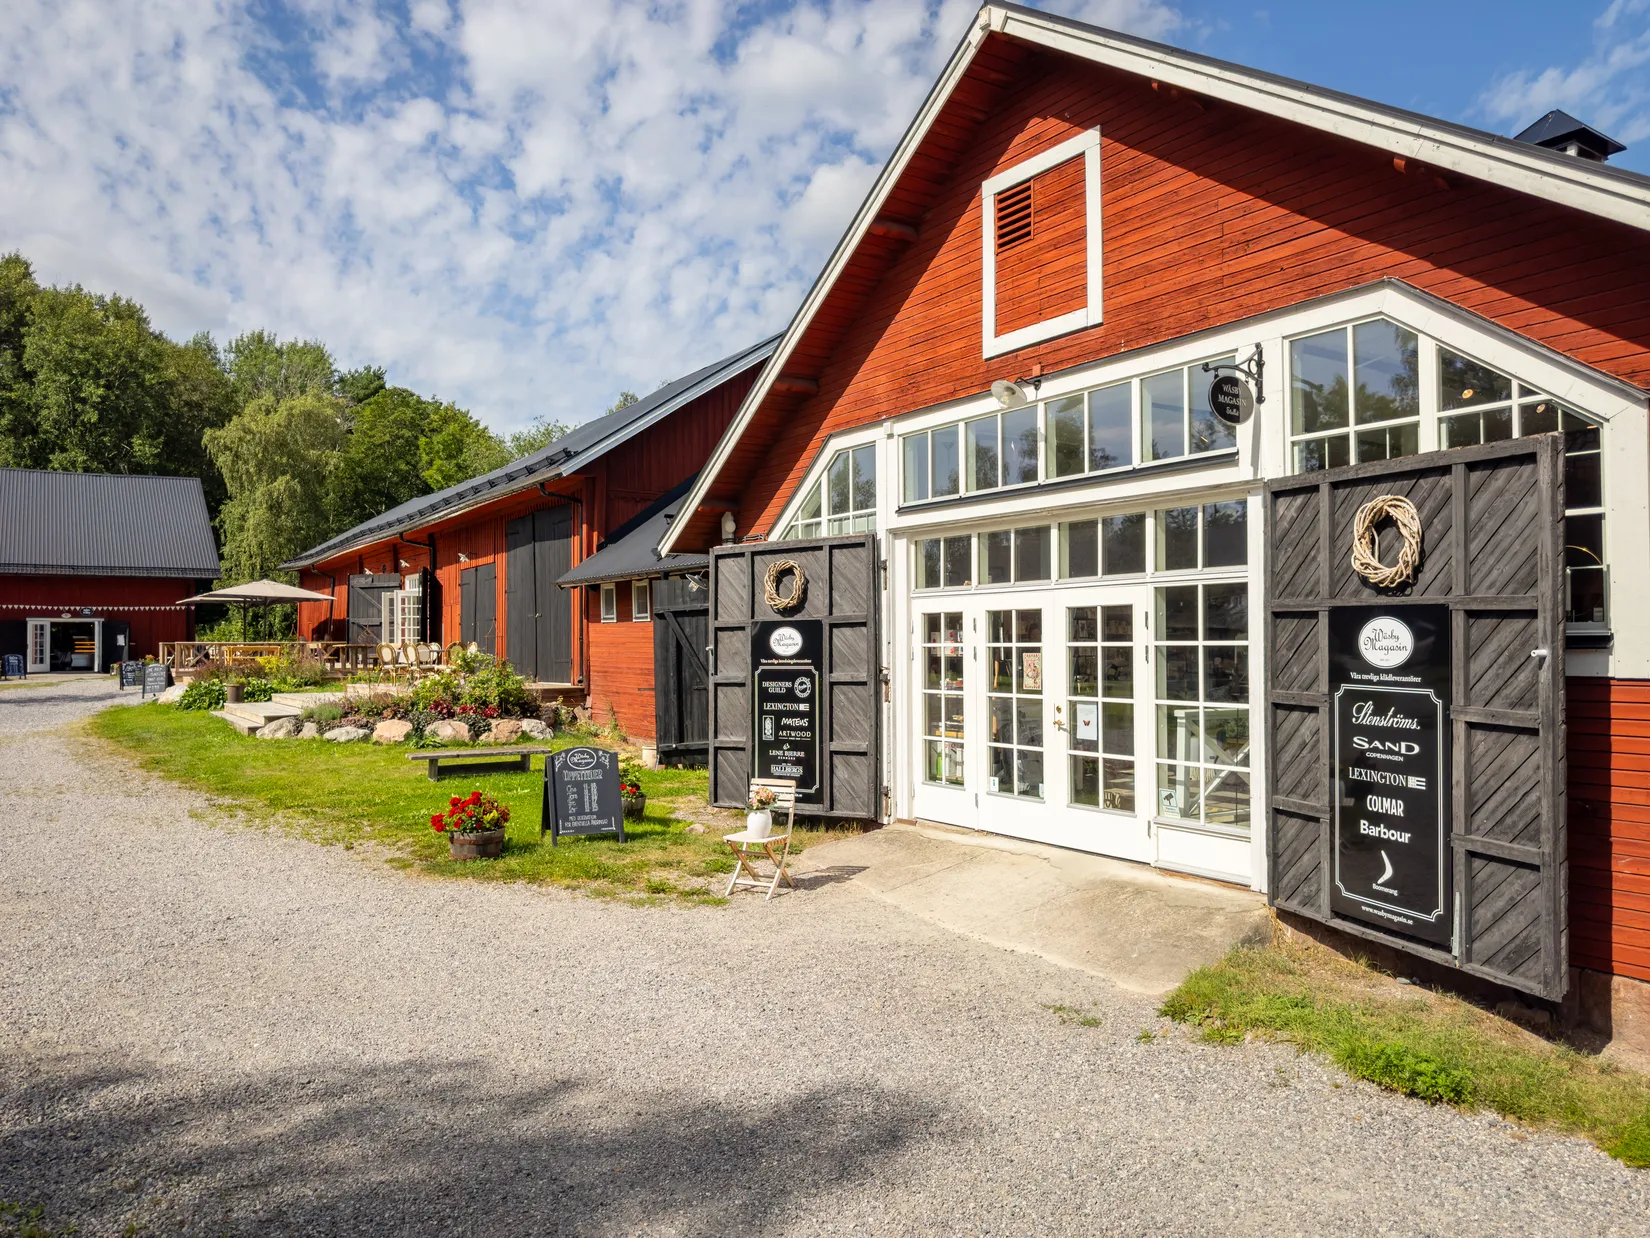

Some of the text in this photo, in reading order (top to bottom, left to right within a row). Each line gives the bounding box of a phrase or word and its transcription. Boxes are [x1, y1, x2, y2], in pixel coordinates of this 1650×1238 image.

[1221, 384, 1242, 394] WÄSBY
[1217, 394, 1247, 406] MAGASIN
[1371, 628, 1400, 642] Wäsby
[1363, 636, 1408, 655] Magasin
[763, 702, 799, 710] LEXINGTON
[1352, 736, 1420, 755] SAND
[1365, 751, 1404, 762] COPENHAGEN
[1348, 766, 1407, 787] LEXINGTON
[1366, 794, 1404, 817] COLMAR
[1360, 819, 1412, 843] Barbour
[1372, 883, 1398, 896] Boomerang
